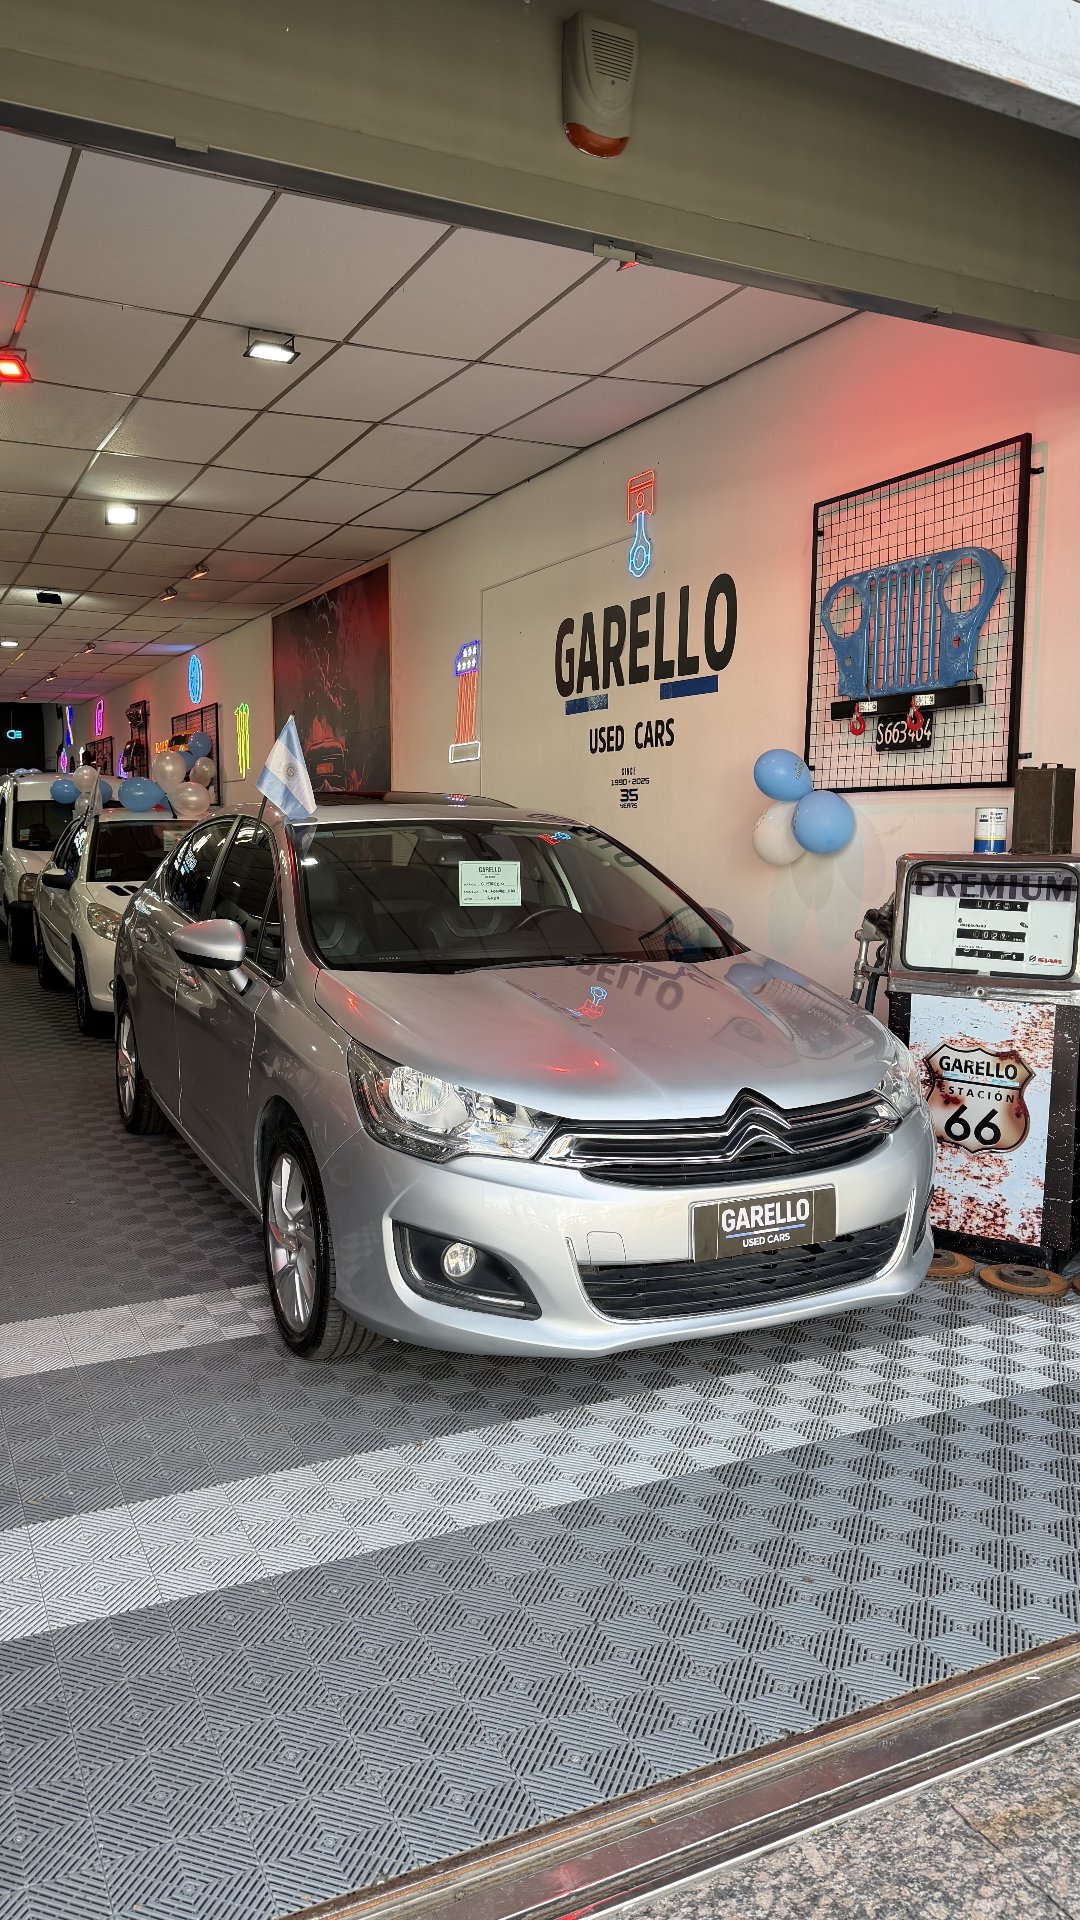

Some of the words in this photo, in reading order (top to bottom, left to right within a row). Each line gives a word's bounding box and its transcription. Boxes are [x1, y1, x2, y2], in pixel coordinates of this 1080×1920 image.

[555, 573, 738, 698] GARELLO
[589, 725, 625, 754] USED
[634, 717, 675, 750] CARS
[619, 788, 639, 802] 35
[915, 872, 1073, 902] PREMIUM
[939, 1055, 1018, 1080] GARELLO
[939, 1086, 1015, 1103] ESTACIÓN
[944, 1104, 1001, 1145] 66
[721, 1198, 810, 1232] GARELLO
[742, 1236, 765, 1247] USED
[767, 1232, 791, 1245] CARS
